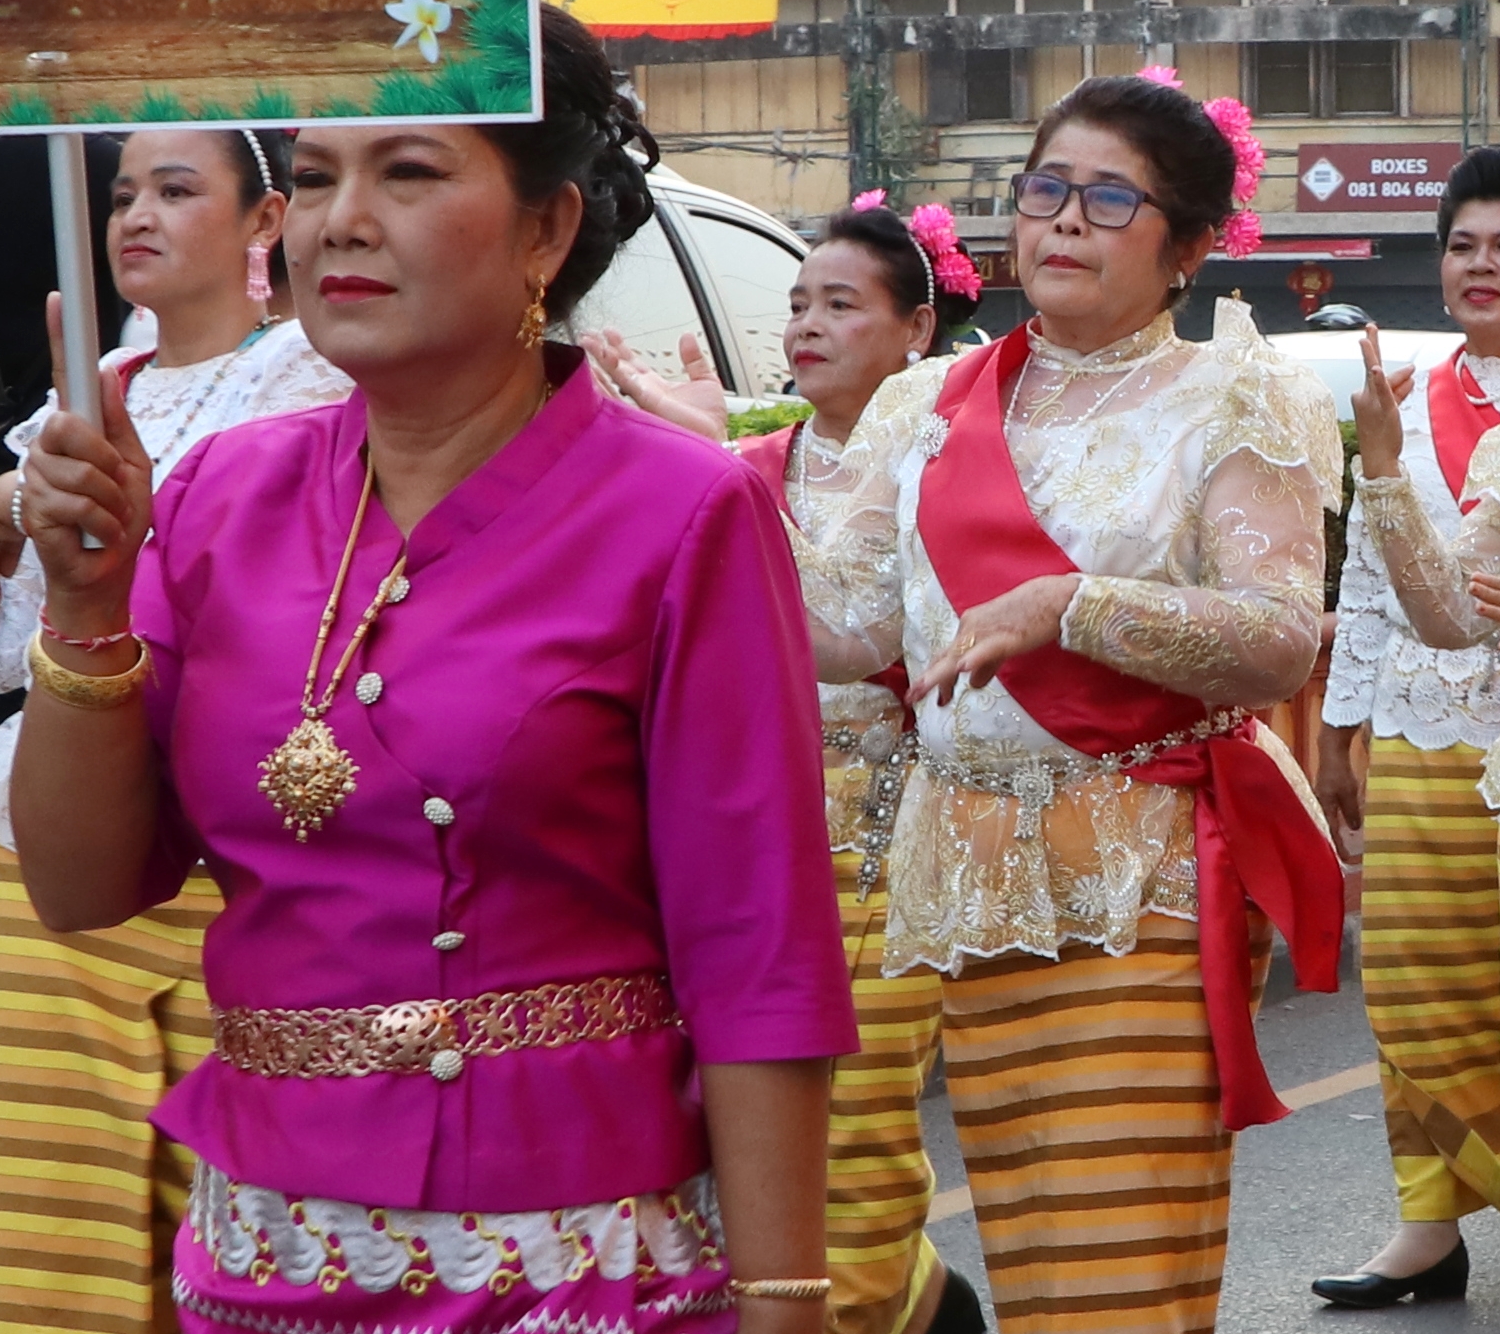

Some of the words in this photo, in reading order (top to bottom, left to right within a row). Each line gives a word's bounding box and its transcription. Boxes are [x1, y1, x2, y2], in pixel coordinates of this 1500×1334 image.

[1371, 159, 1428, 174] BOXES
[1348, 181, 1377, 197] 081
[1381, 181, 1411, 197] 804
[1414, 181, 1448, 197] 660
